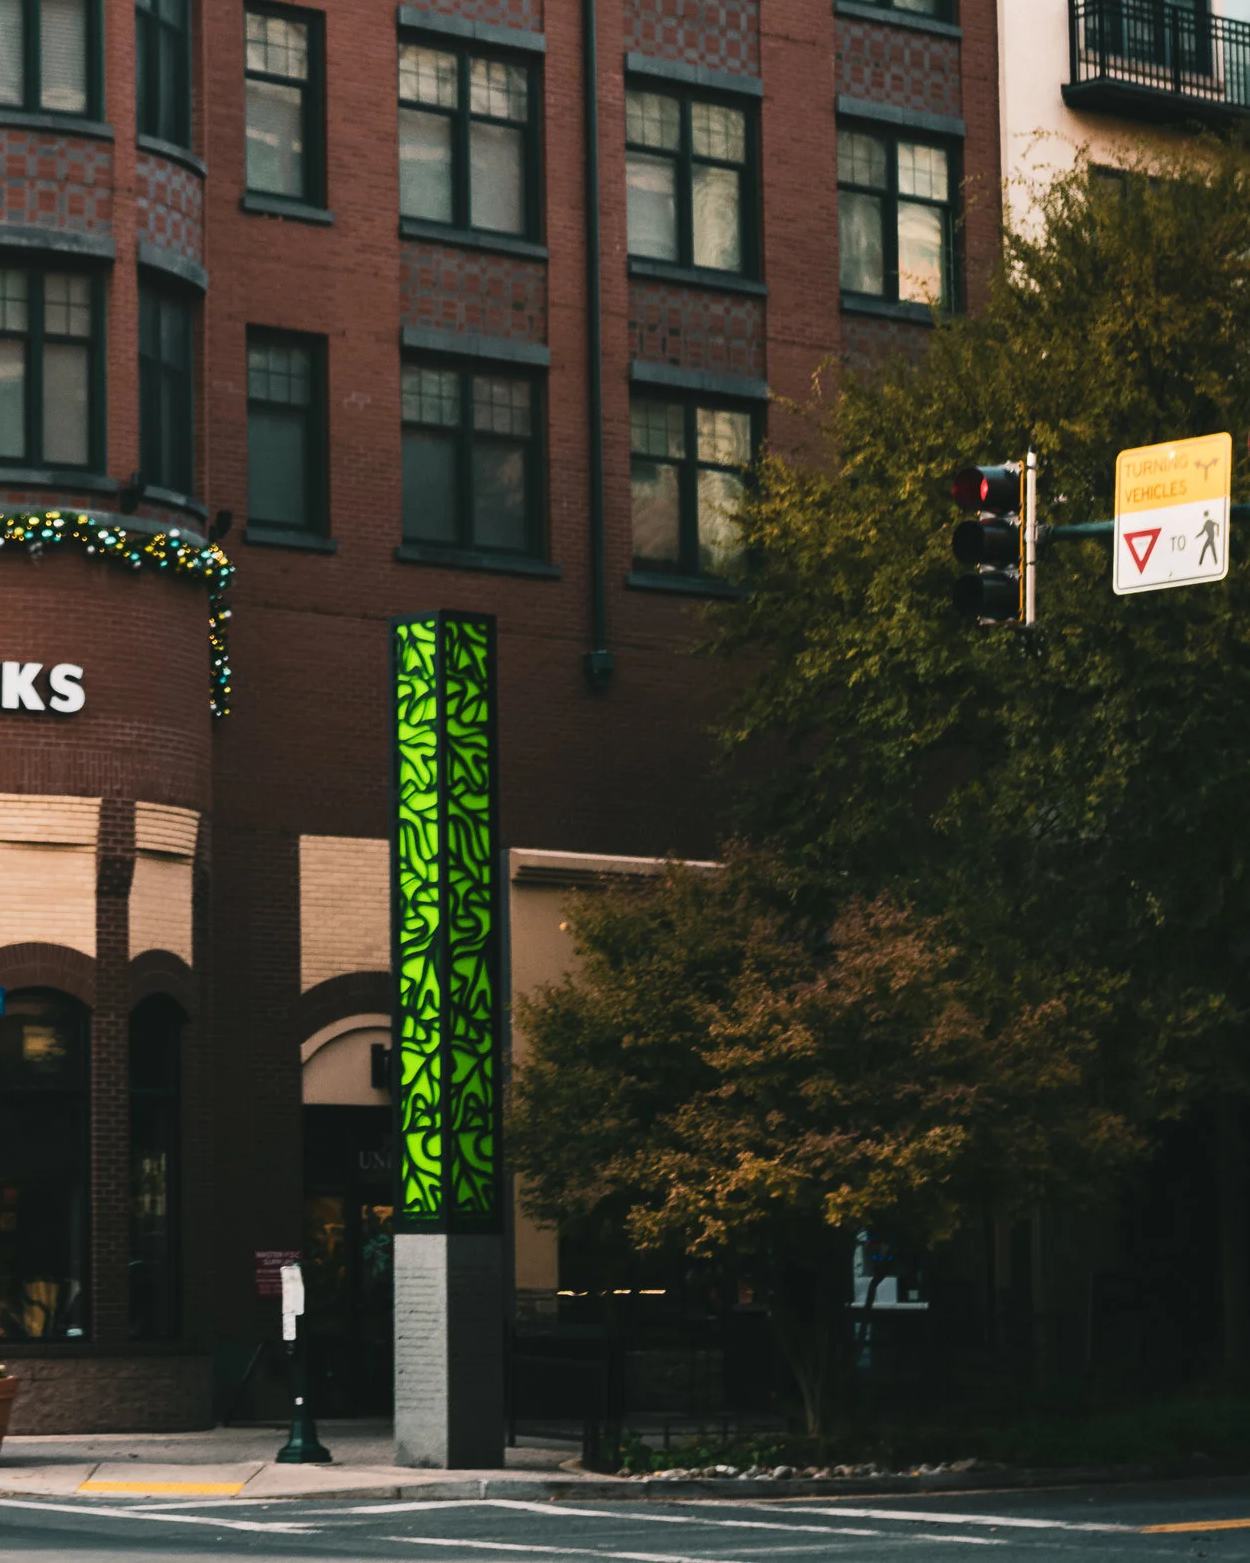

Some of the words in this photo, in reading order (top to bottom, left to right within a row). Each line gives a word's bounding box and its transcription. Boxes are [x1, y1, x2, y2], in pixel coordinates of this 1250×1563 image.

[1125, 454, 1188, 479] TURNING
[1125, 480, 1188, 504] VEHICLES
[1170, 534, 1186, 552] TO
